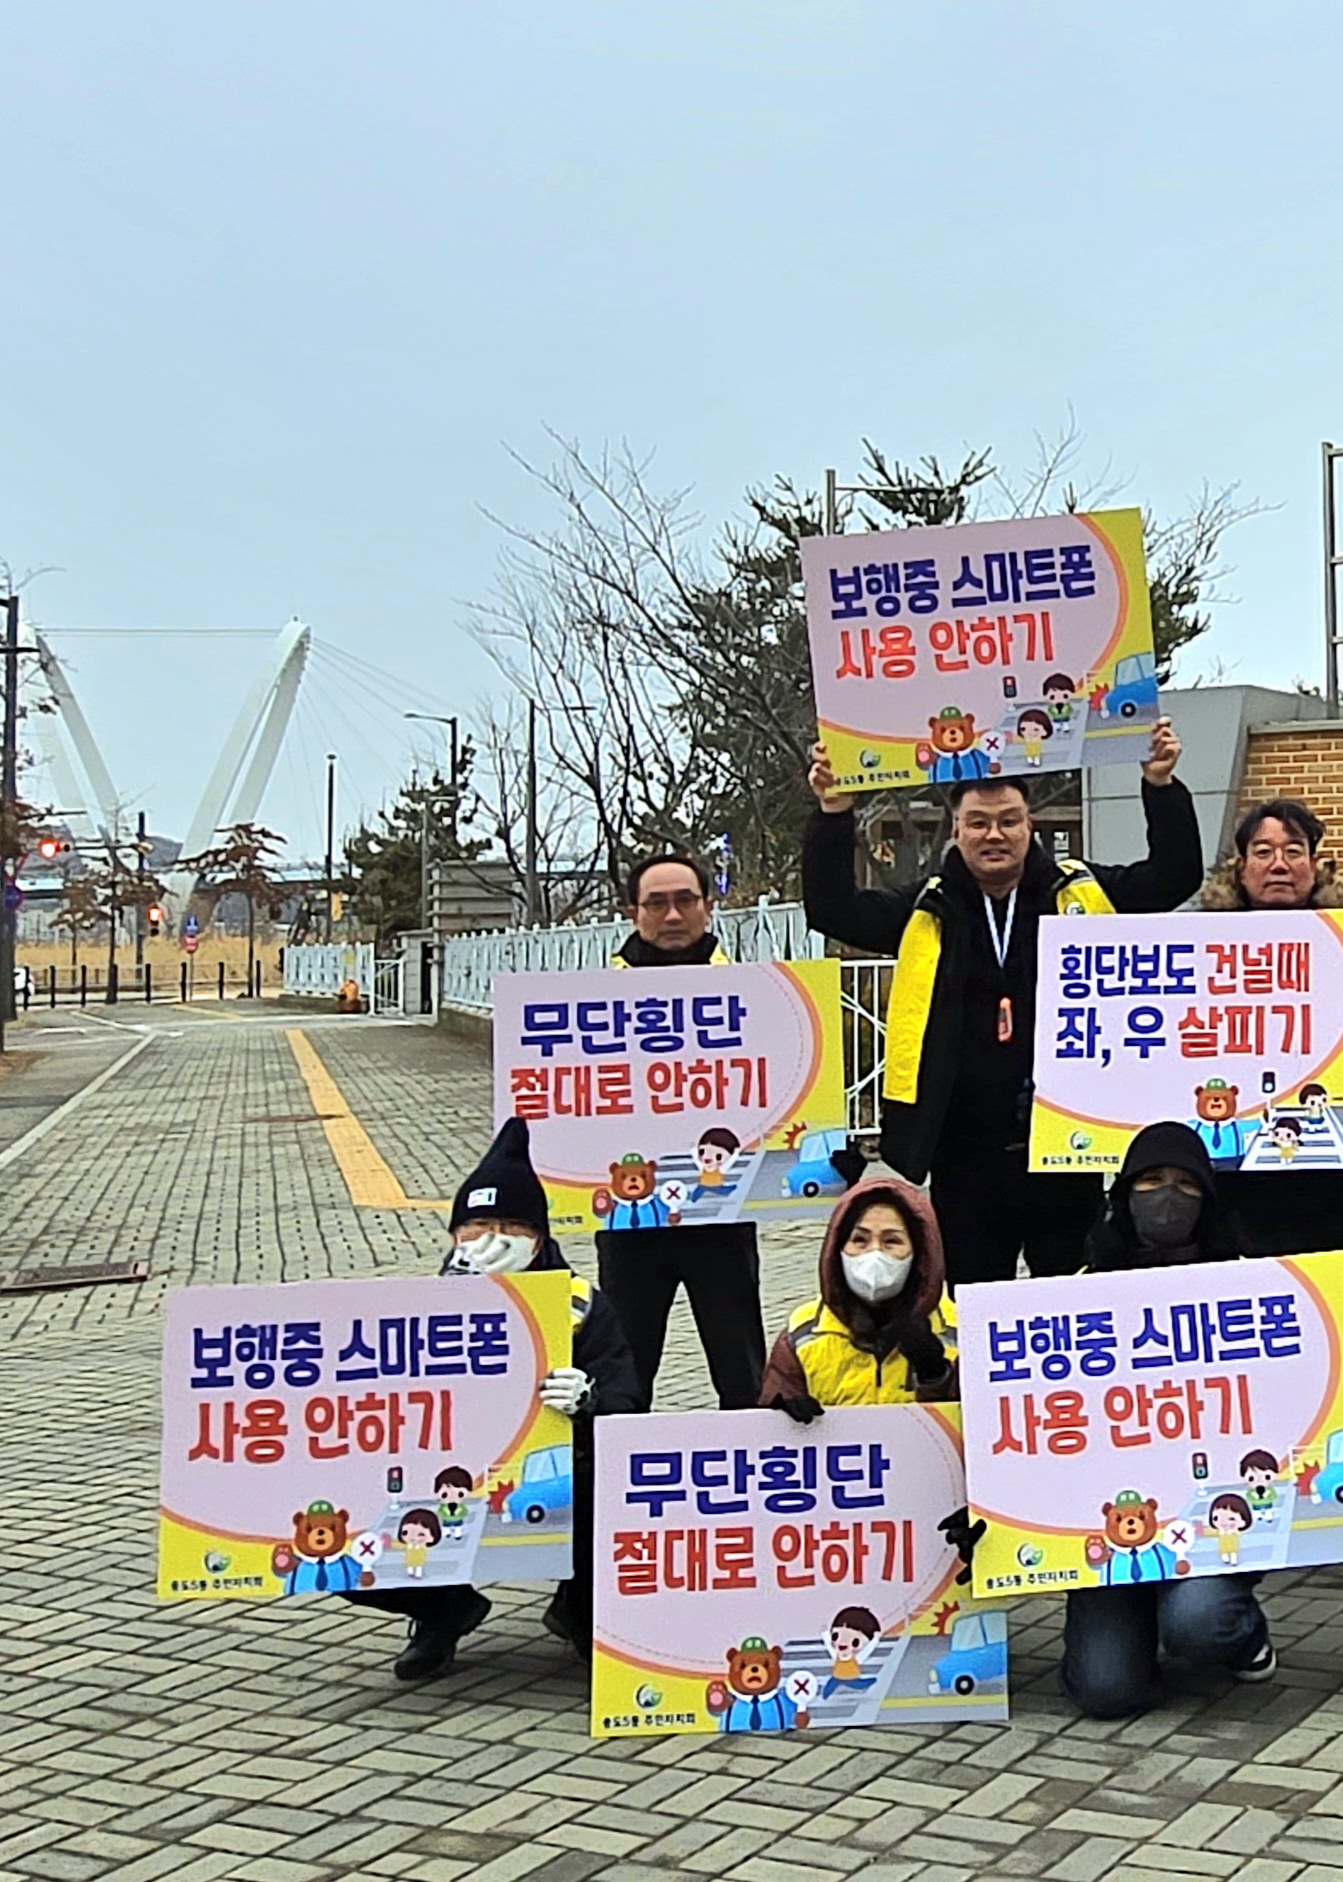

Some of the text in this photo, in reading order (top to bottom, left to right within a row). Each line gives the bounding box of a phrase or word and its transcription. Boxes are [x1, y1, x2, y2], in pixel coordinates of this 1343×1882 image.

[829, 545, 1096, 620] 보행중 스마트폰
[836, 611, 1053, 679] 사용 안하기
[1059, 942, 1311, 999] 횡단보도 건널때
[521, 995, 747, 1057] 무단횡단
[1055, 1003, 1311, 1068] 좌, 우 살피기
[510, 1057, 768, 1120] 절대로 안하기
[190, 1312, 510, 1390] 보행중 스마트폰
[988, 1294, 1301, 1382] 보행중 스마트폰
[188, 1390, 453, 1464] 사용 안하기
[992, 1374, 1252, 1455] 사용 안하기
[626, 1444, 890, 1518] 무단횡단
[613, 1520, 914, 1596] 절대로 안하기
